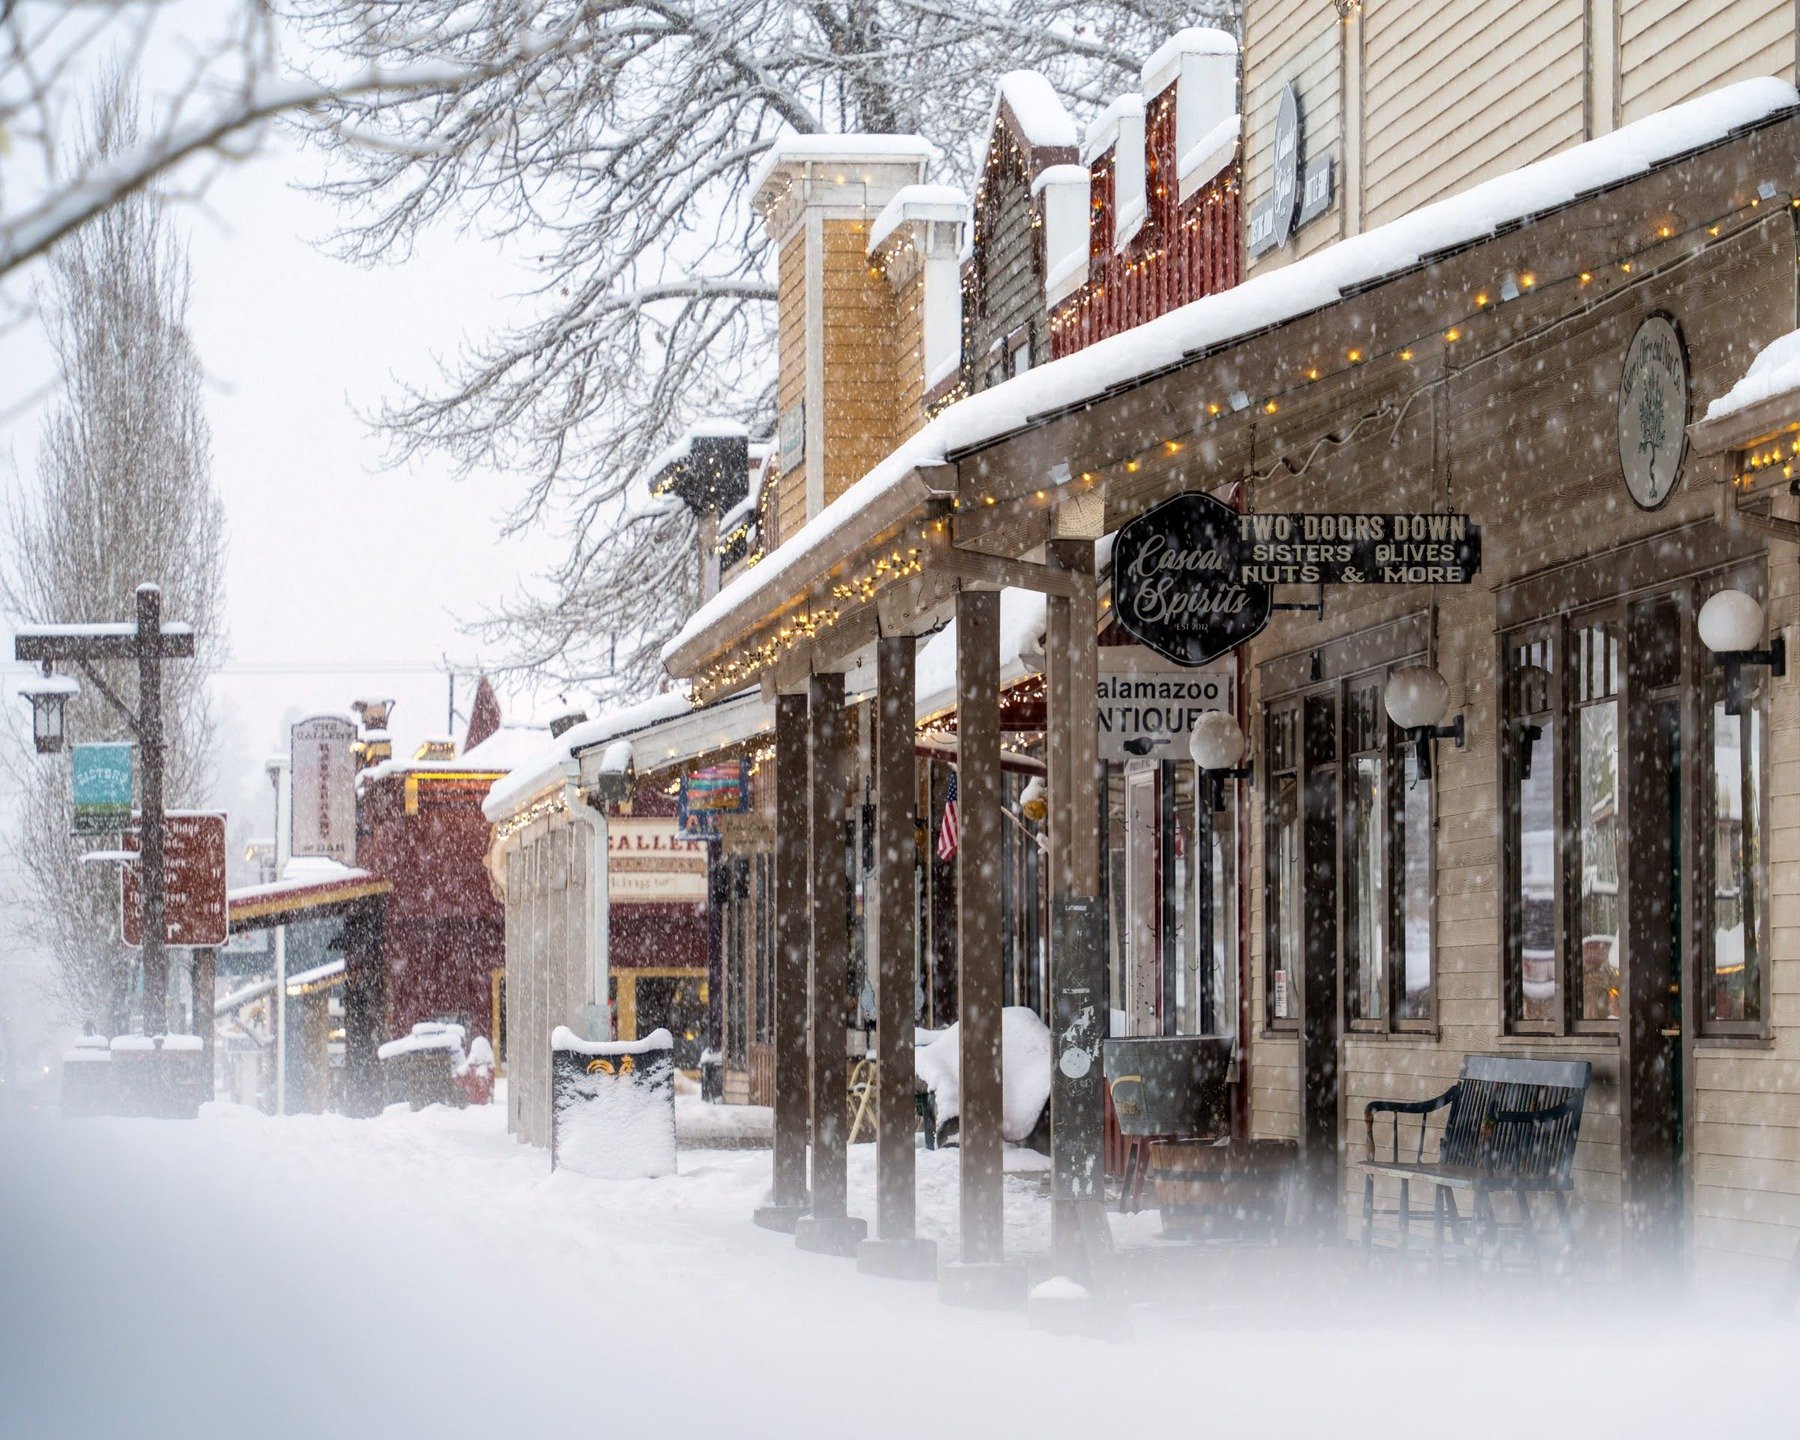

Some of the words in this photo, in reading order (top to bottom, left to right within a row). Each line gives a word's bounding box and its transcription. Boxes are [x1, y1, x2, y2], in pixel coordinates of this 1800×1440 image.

[1238, 515, 1291, 540] TWO
[1304, 515, 1384, 541] DOORS
[1394, 515, 1466, 541] DOWN
[1375, 544, 1455, 562] OLIVES
[1241, 565, 1320, 583] NUTS
[1341, 566, 1365, 582] &
[1384, 566, 1462, 582] MORE
[1133, 578, 1251, 625] Spirits
[1098, 707, 1221, 734] NTIQUE
